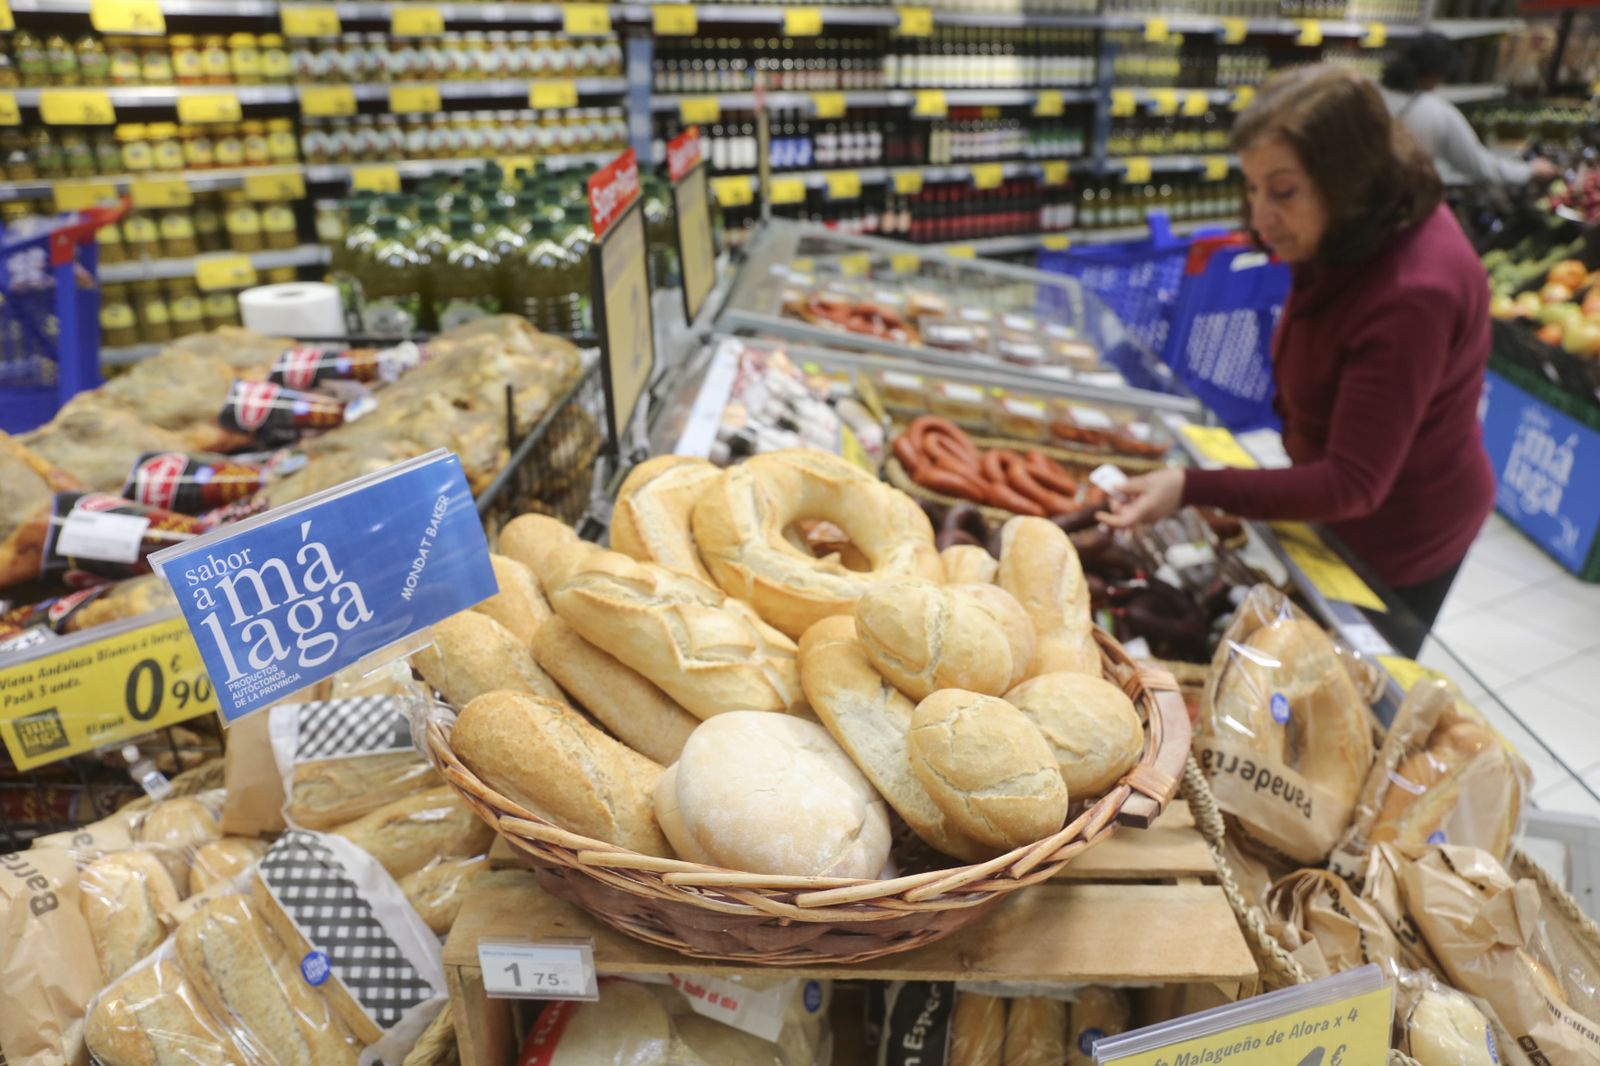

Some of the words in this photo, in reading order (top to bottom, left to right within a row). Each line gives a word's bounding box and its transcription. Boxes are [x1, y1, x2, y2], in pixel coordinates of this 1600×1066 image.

[425, 495, 450, 538] BAKER
[185, 547, 251, 586] sabor
[193, 586, 216, 610] a
[214, 520, 344, 626] má
[200, 581, 374, 685] laga
[125, 658, 164, 722] 0
[171, 674, 211, 710] 90
[228, 664, 278, 692] PRODUCTOS
[234, 698, 248, 709] DE
[247, 692, 260, 702] LA
[259, 672, 301, 697] PROVINCIA
[4, 690, 33, 708] Pack
[504, 962, 522, 987] 1
[533, 971, 559, 986] 75
[1174, 1036, 1261, 1066] Malagueño
[1265, 1030, 1283, 1046] de
[1288, 1020, 1329, 1040] Alora
[1333, 1016, 1342, 1028] x
[1347, 1006, 1358, 1022] 4
